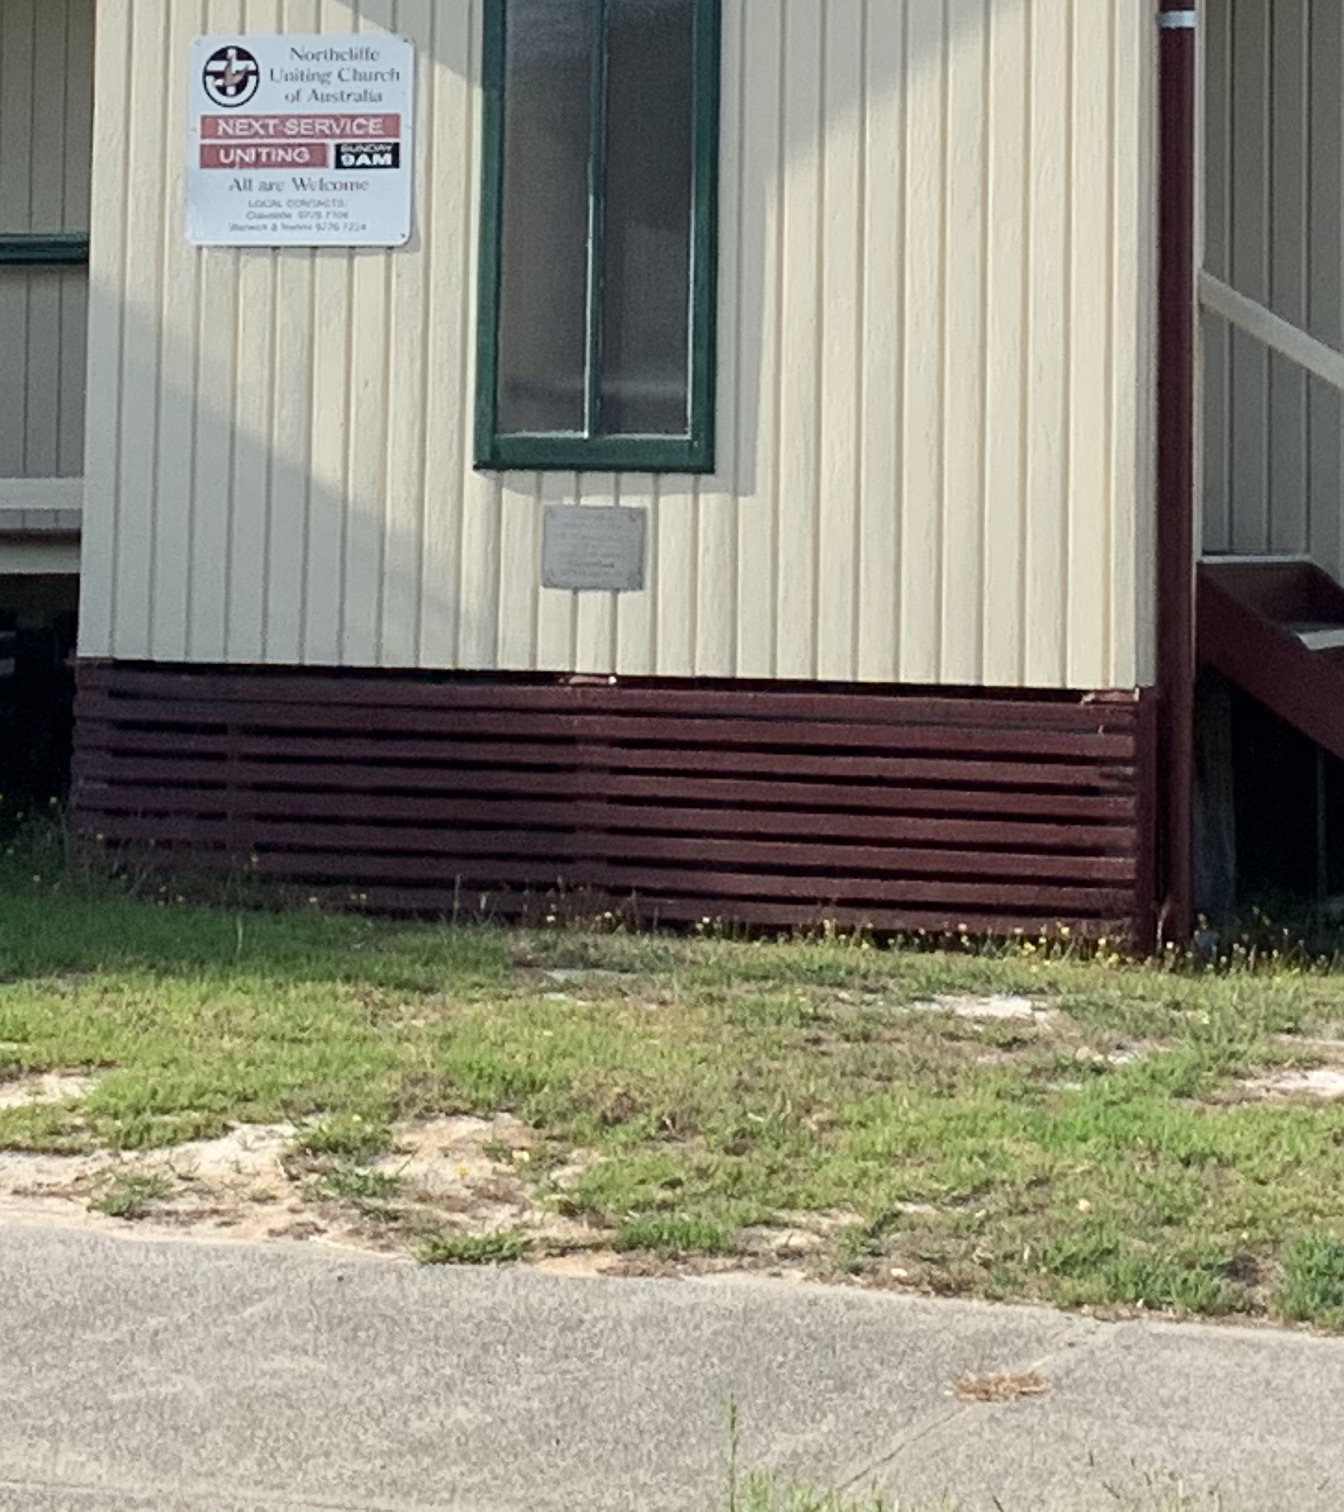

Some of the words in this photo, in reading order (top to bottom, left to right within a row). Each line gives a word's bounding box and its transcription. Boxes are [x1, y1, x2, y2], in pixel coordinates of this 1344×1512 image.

[289, 46, 380, 62] Northcliffe
[269, 68, 332, 85] Uniting
[337, 68, 400, 82] Church
[284, 88, 301, 103] of
[306, 88, 383, 103] Australia
[217, 119, 281, 136] NEXT
[283, 118, 384, 136] SERVICE
[219, 146, 310, 164] UNITING
[340, 143, 392, 152] SUNDAY
[341, 152, 392, 167] 9AM
[229, 176, 253, 192] All
[258, 179, 285, 192] are
[292, 176, 369, 192] Welcome
